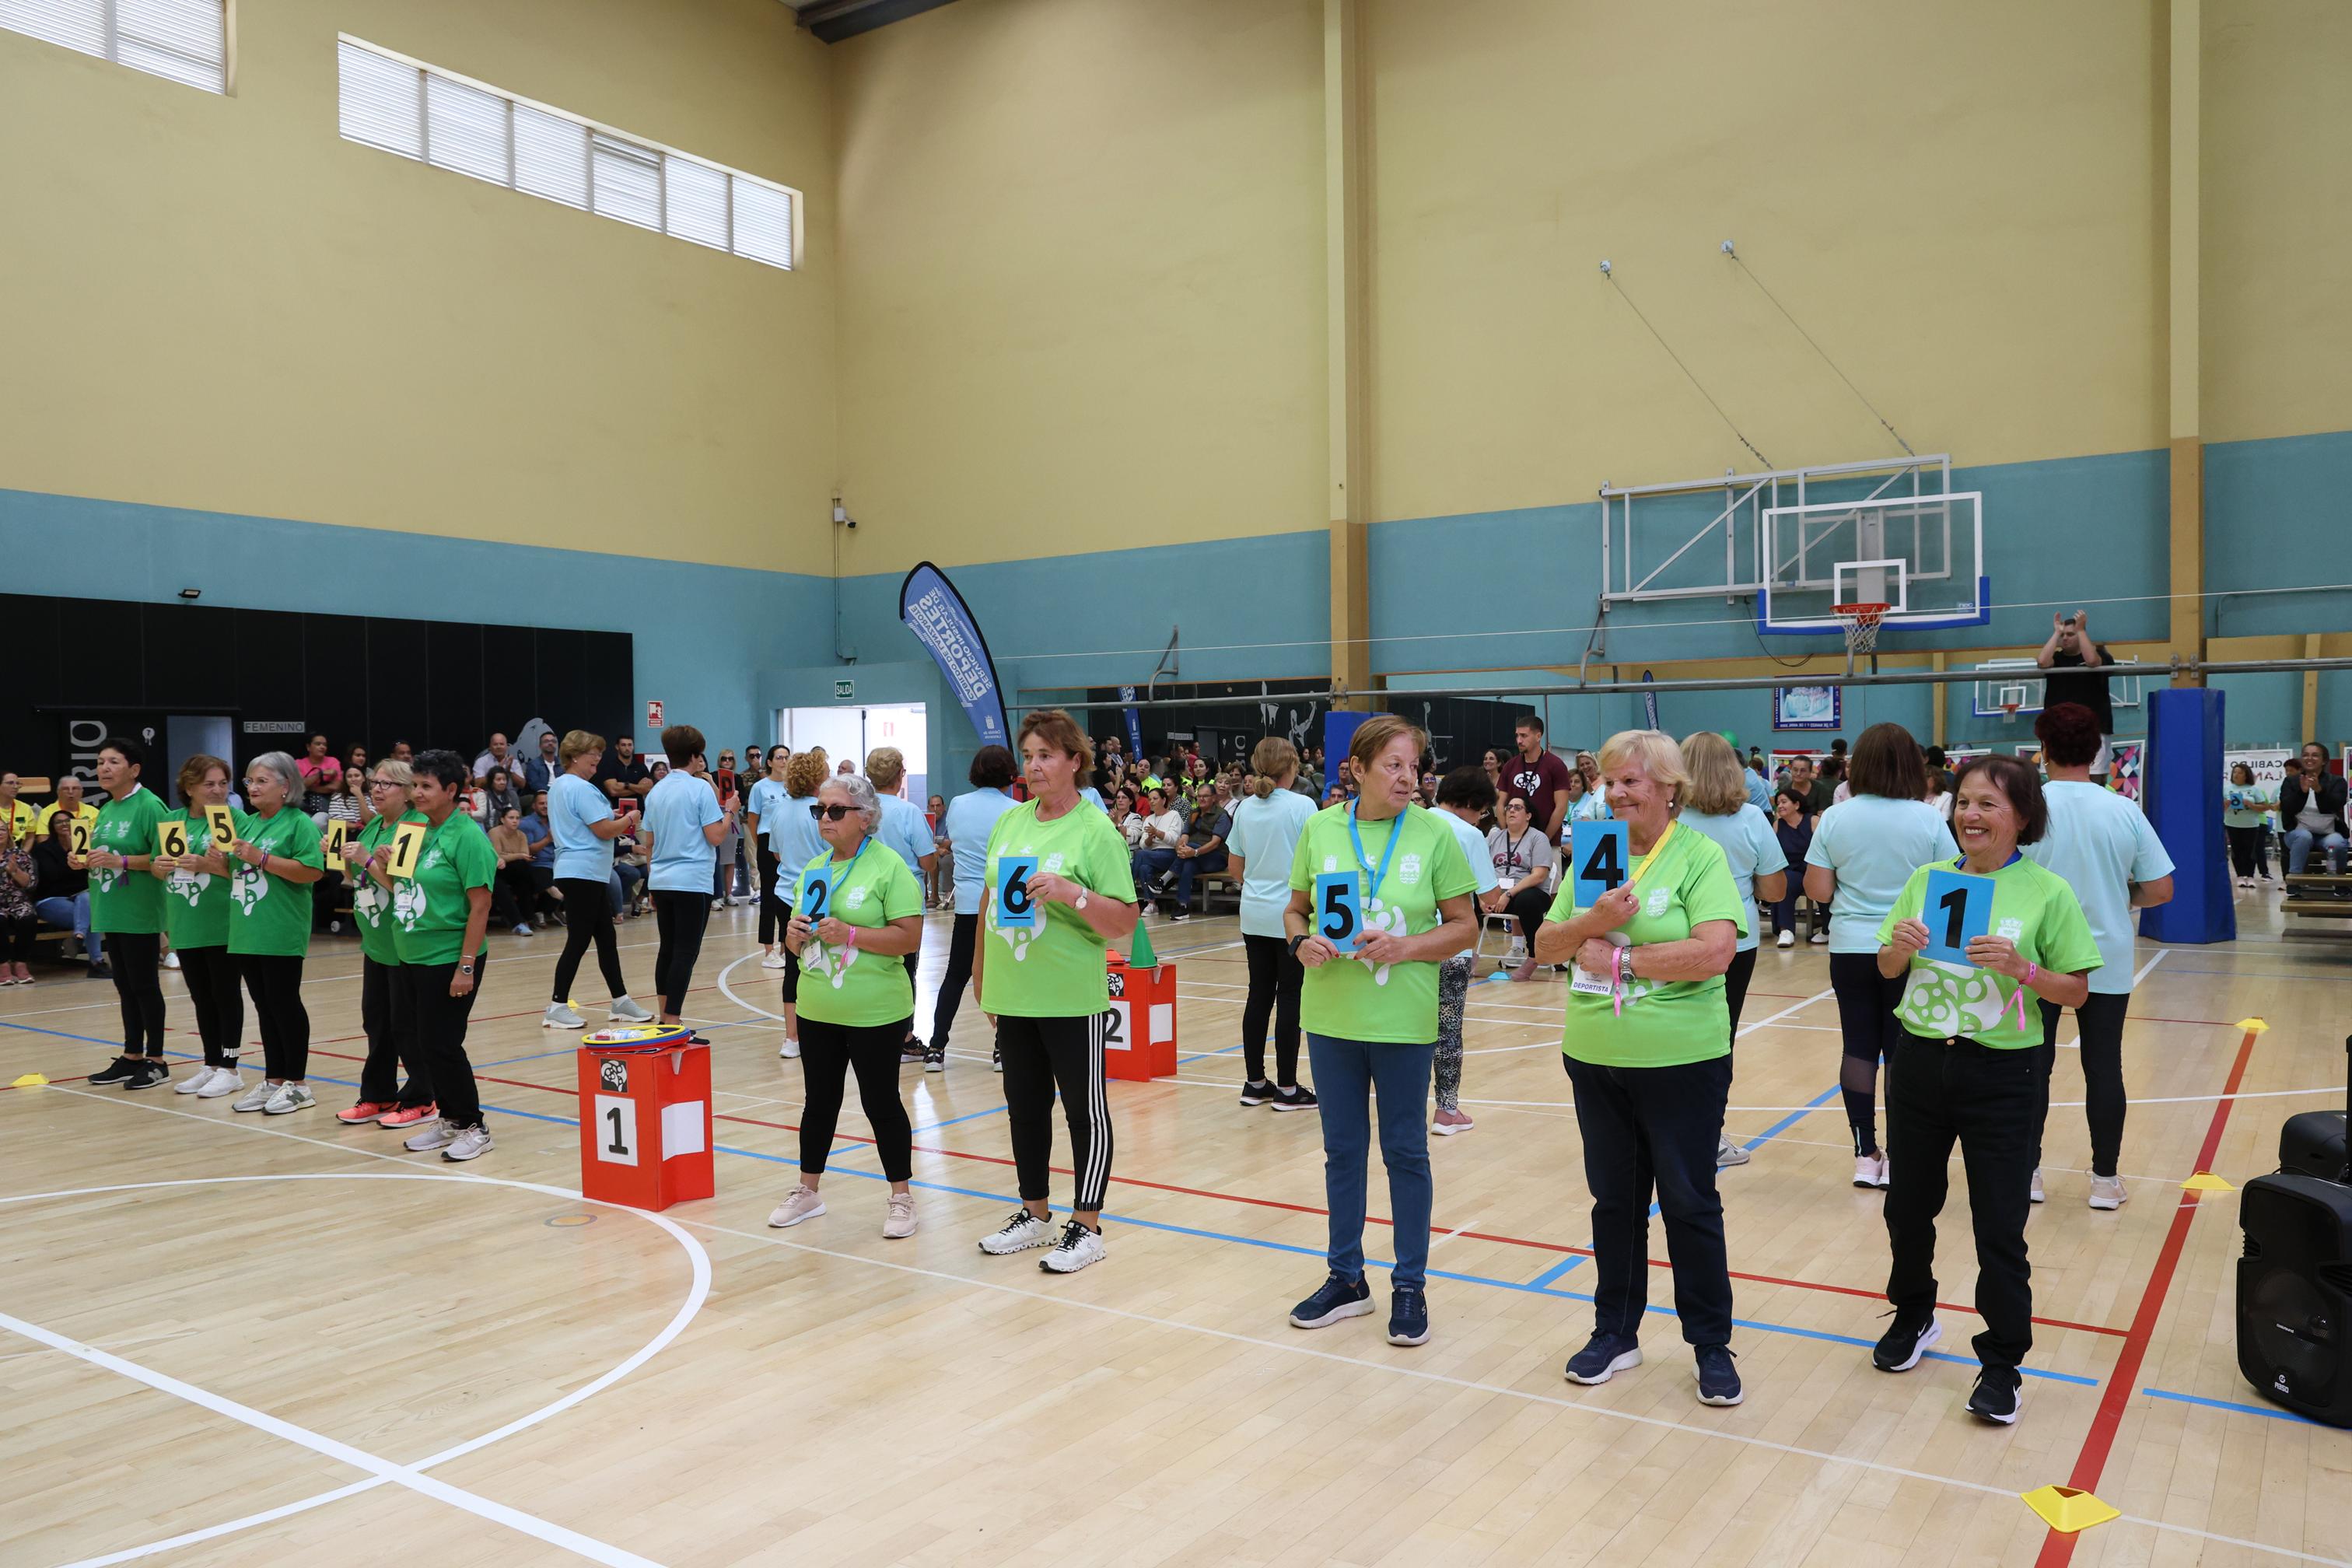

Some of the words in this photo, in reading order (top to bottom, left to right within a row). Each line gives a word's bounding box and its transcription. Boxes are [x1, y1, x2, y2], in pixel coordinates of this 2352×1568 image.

[245, 723, 303, 731] FEMENINO
[74, 826, 88, 855] 2
[166, 828, 184, 857] 6
[213, 813, 232, 843] 5
[329, 828, 341, 861] 4
[398, 833, 411, 866] 1
[1580, 834, 1623, 891] 4
[807, 879, 827, 923] 2
[1003, 866, 1031, 914] 6
[1324, 884, 1353, 940] 5
[1940, 887, 1968, 949] 1
[1573, 982, 1608, 992] DEPORTISTA
[1106, 1007, 1123, 1043] 2
[607, 1108, 628, 1155] 1
